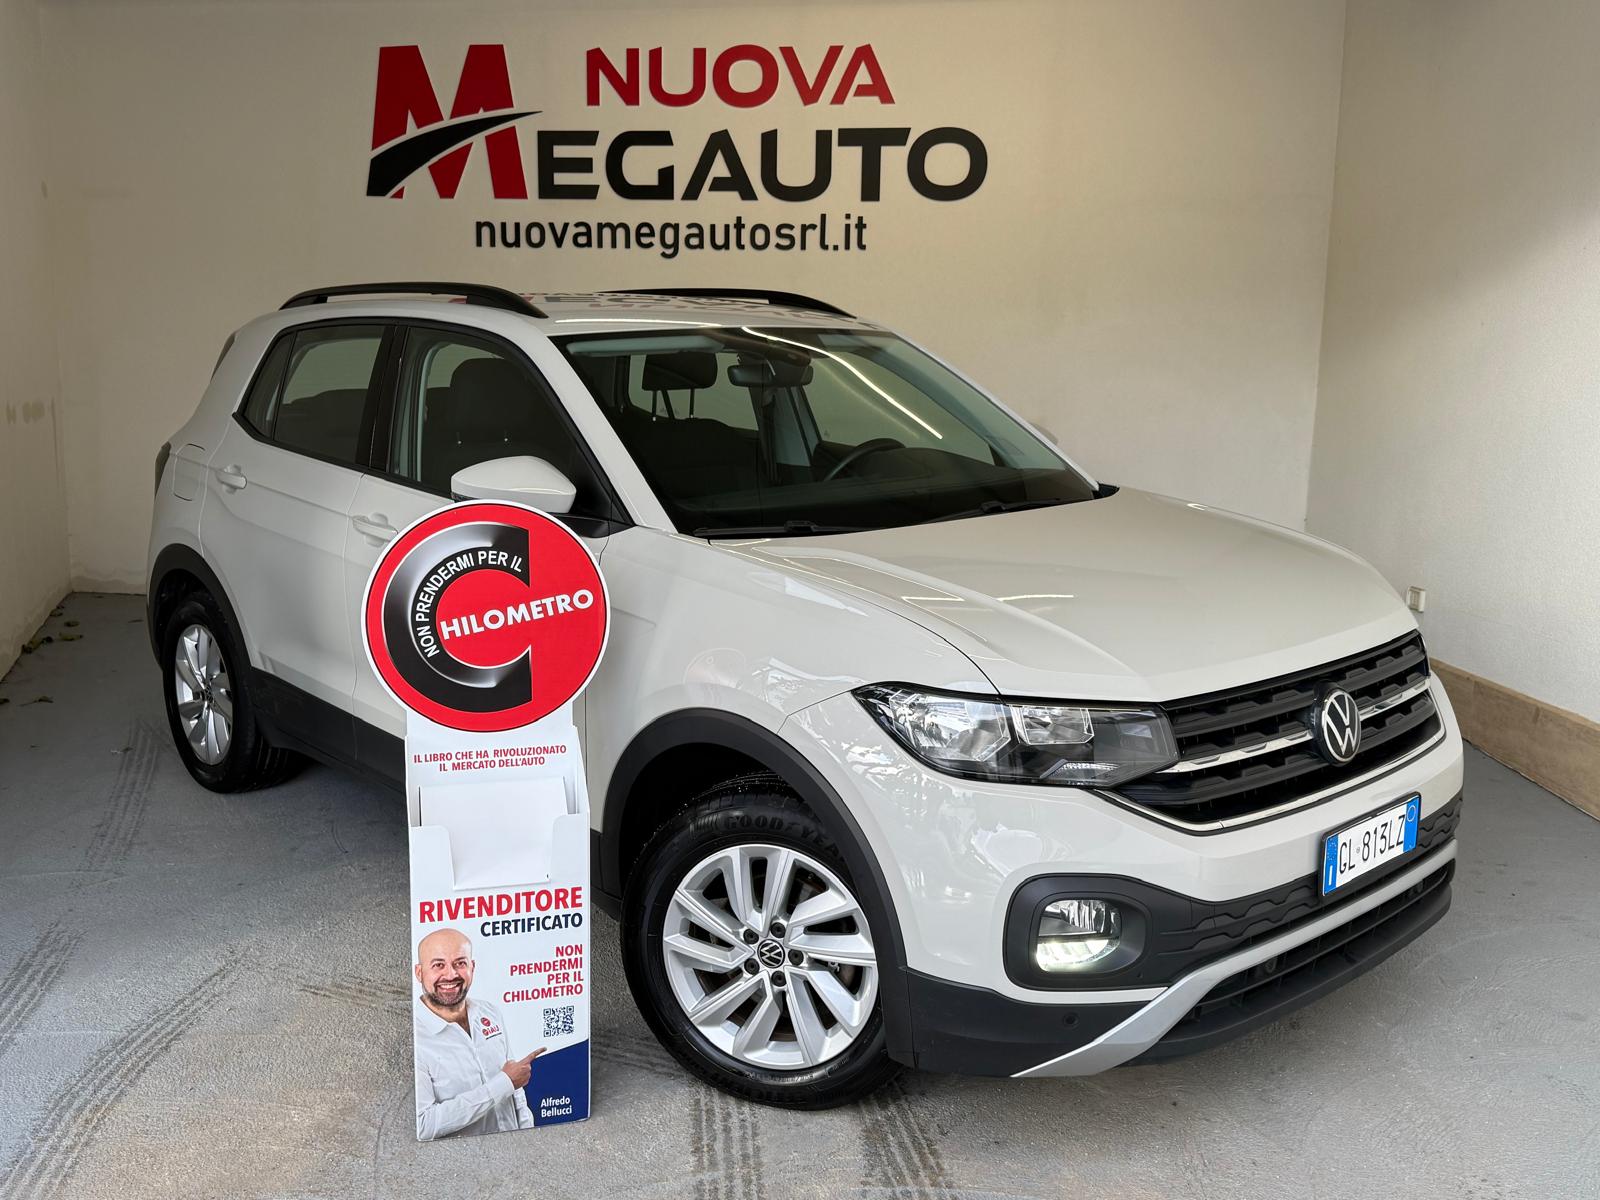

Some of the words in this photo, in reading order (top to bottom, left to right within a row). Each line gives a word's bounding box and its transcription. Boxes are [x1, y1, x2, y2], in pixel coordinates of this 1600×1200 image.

[586, 43, 896, 108] NUOVA
[475, 213, 868, 259] nuovamegautosrl.it
[478, 550, 509, 567] PER
[511, 555, 523, 573] IL
[415, 552, 475, 622] PRENDERMI
[416, 625, 440, 658] NON
[413, 754, 423, 764] IL
[424, 752, 453, 763] LIBRO
[455, 751, 473, 761] CHE
[475, 750, 489, 760] HA
[493, 744, 567, 758] RIVOLUZIONATO
[439, 763, 448, 772] IL
[451, 760, 496, 771] MERCATO
[498, 756, 546, 768] DELL'AUTO
[724, 813, 848, 865] GOODYEA
[1338, 839, 1356, 875] GL
[1361, 814, 1406, 863] 813LZ
[418, 886, 583, 924] RIVENDITORE
[480, 912, 583, 937] CERTIFICATO
[555, 944, 583, 958] NON
[509, 957, 583, 976] PRENDERMI
[547, 972, 571, 985] PER
[573, 971, 584, 983] IL
[502, 983, 583, 1004] CHILOMETRO
[540, 1095, 571, 1108] Alfredo
[540, 1105, 572, 1118] Bellucci
